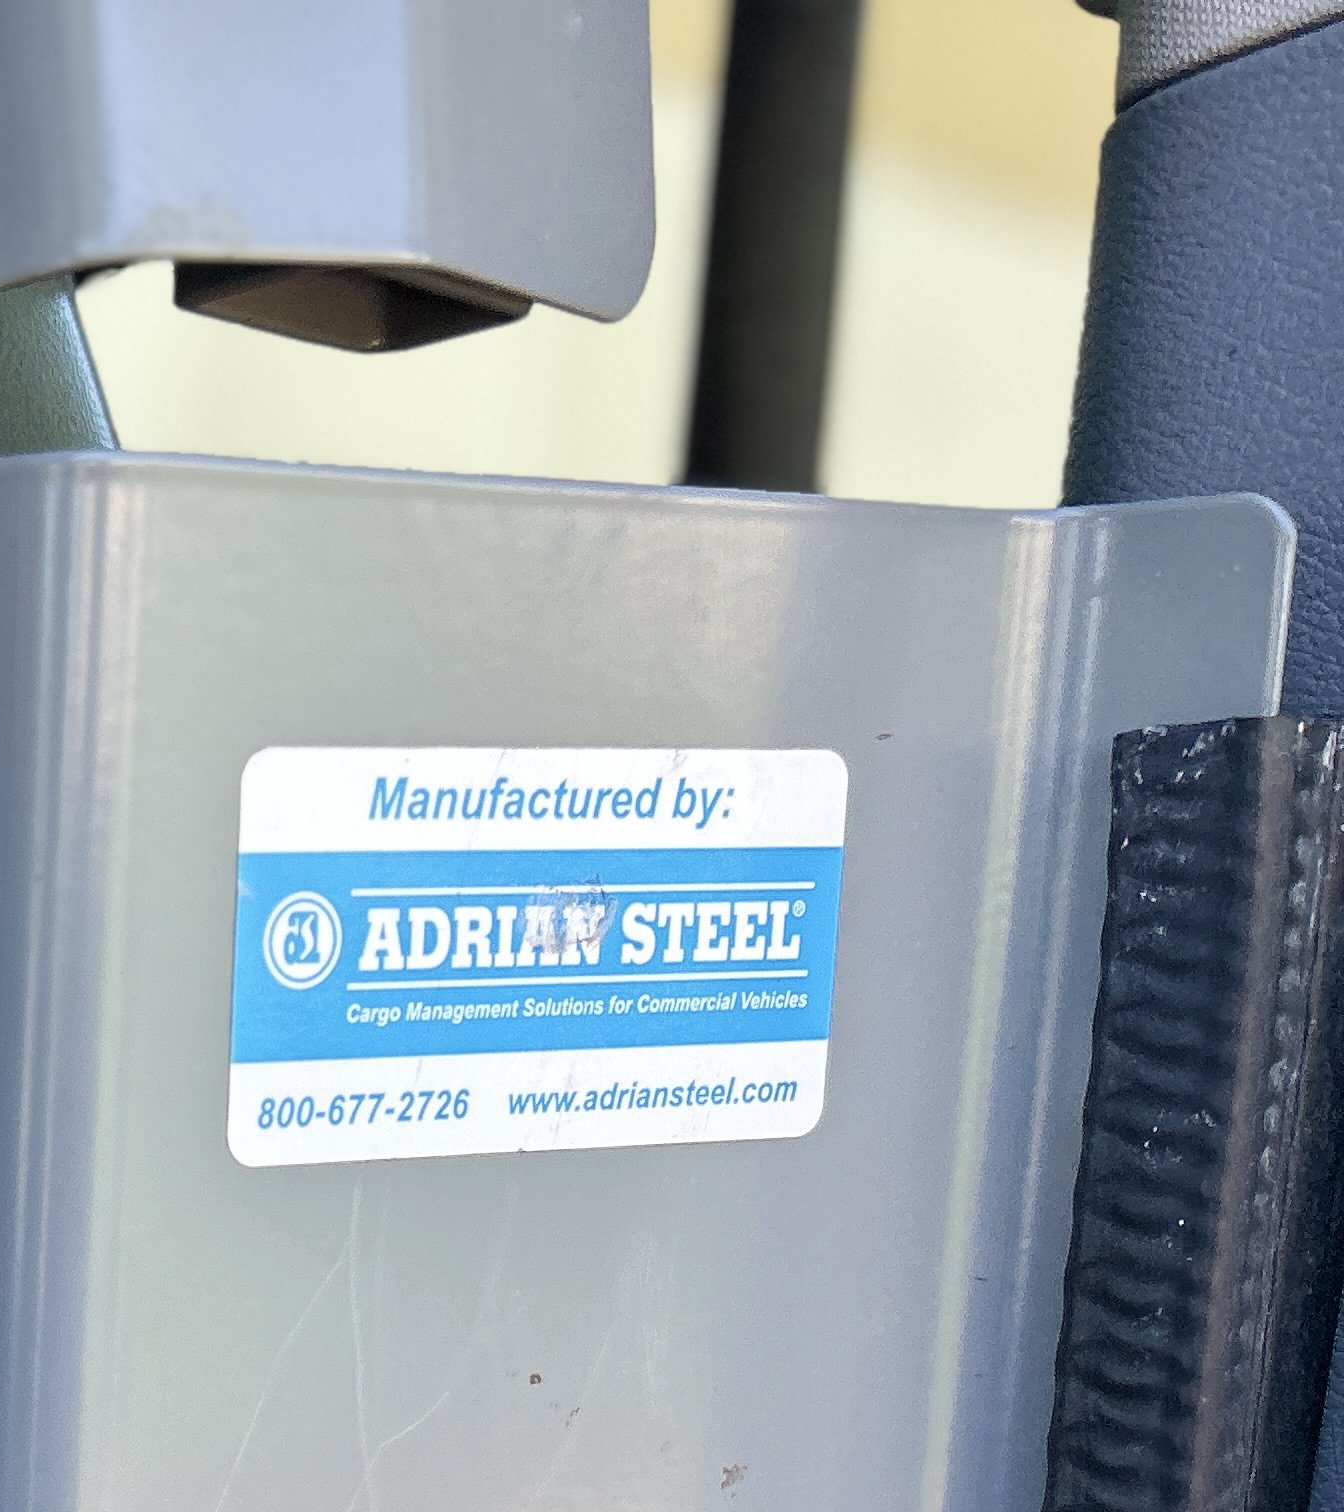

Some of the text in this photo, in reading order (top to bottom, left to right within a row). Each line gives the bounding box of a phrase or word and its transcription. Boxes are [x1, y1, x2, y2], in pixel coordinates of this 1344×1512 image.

[368, 776, 735, 830] Manufactured by:
[357, 904, 605, 973] ADRIAN
[346, 989, 809, 1027] Cargo Management Solutions for Commercial Vehicles
[257, 1076, 798, 1130] 800-677-2726 www.adriansteel.com
